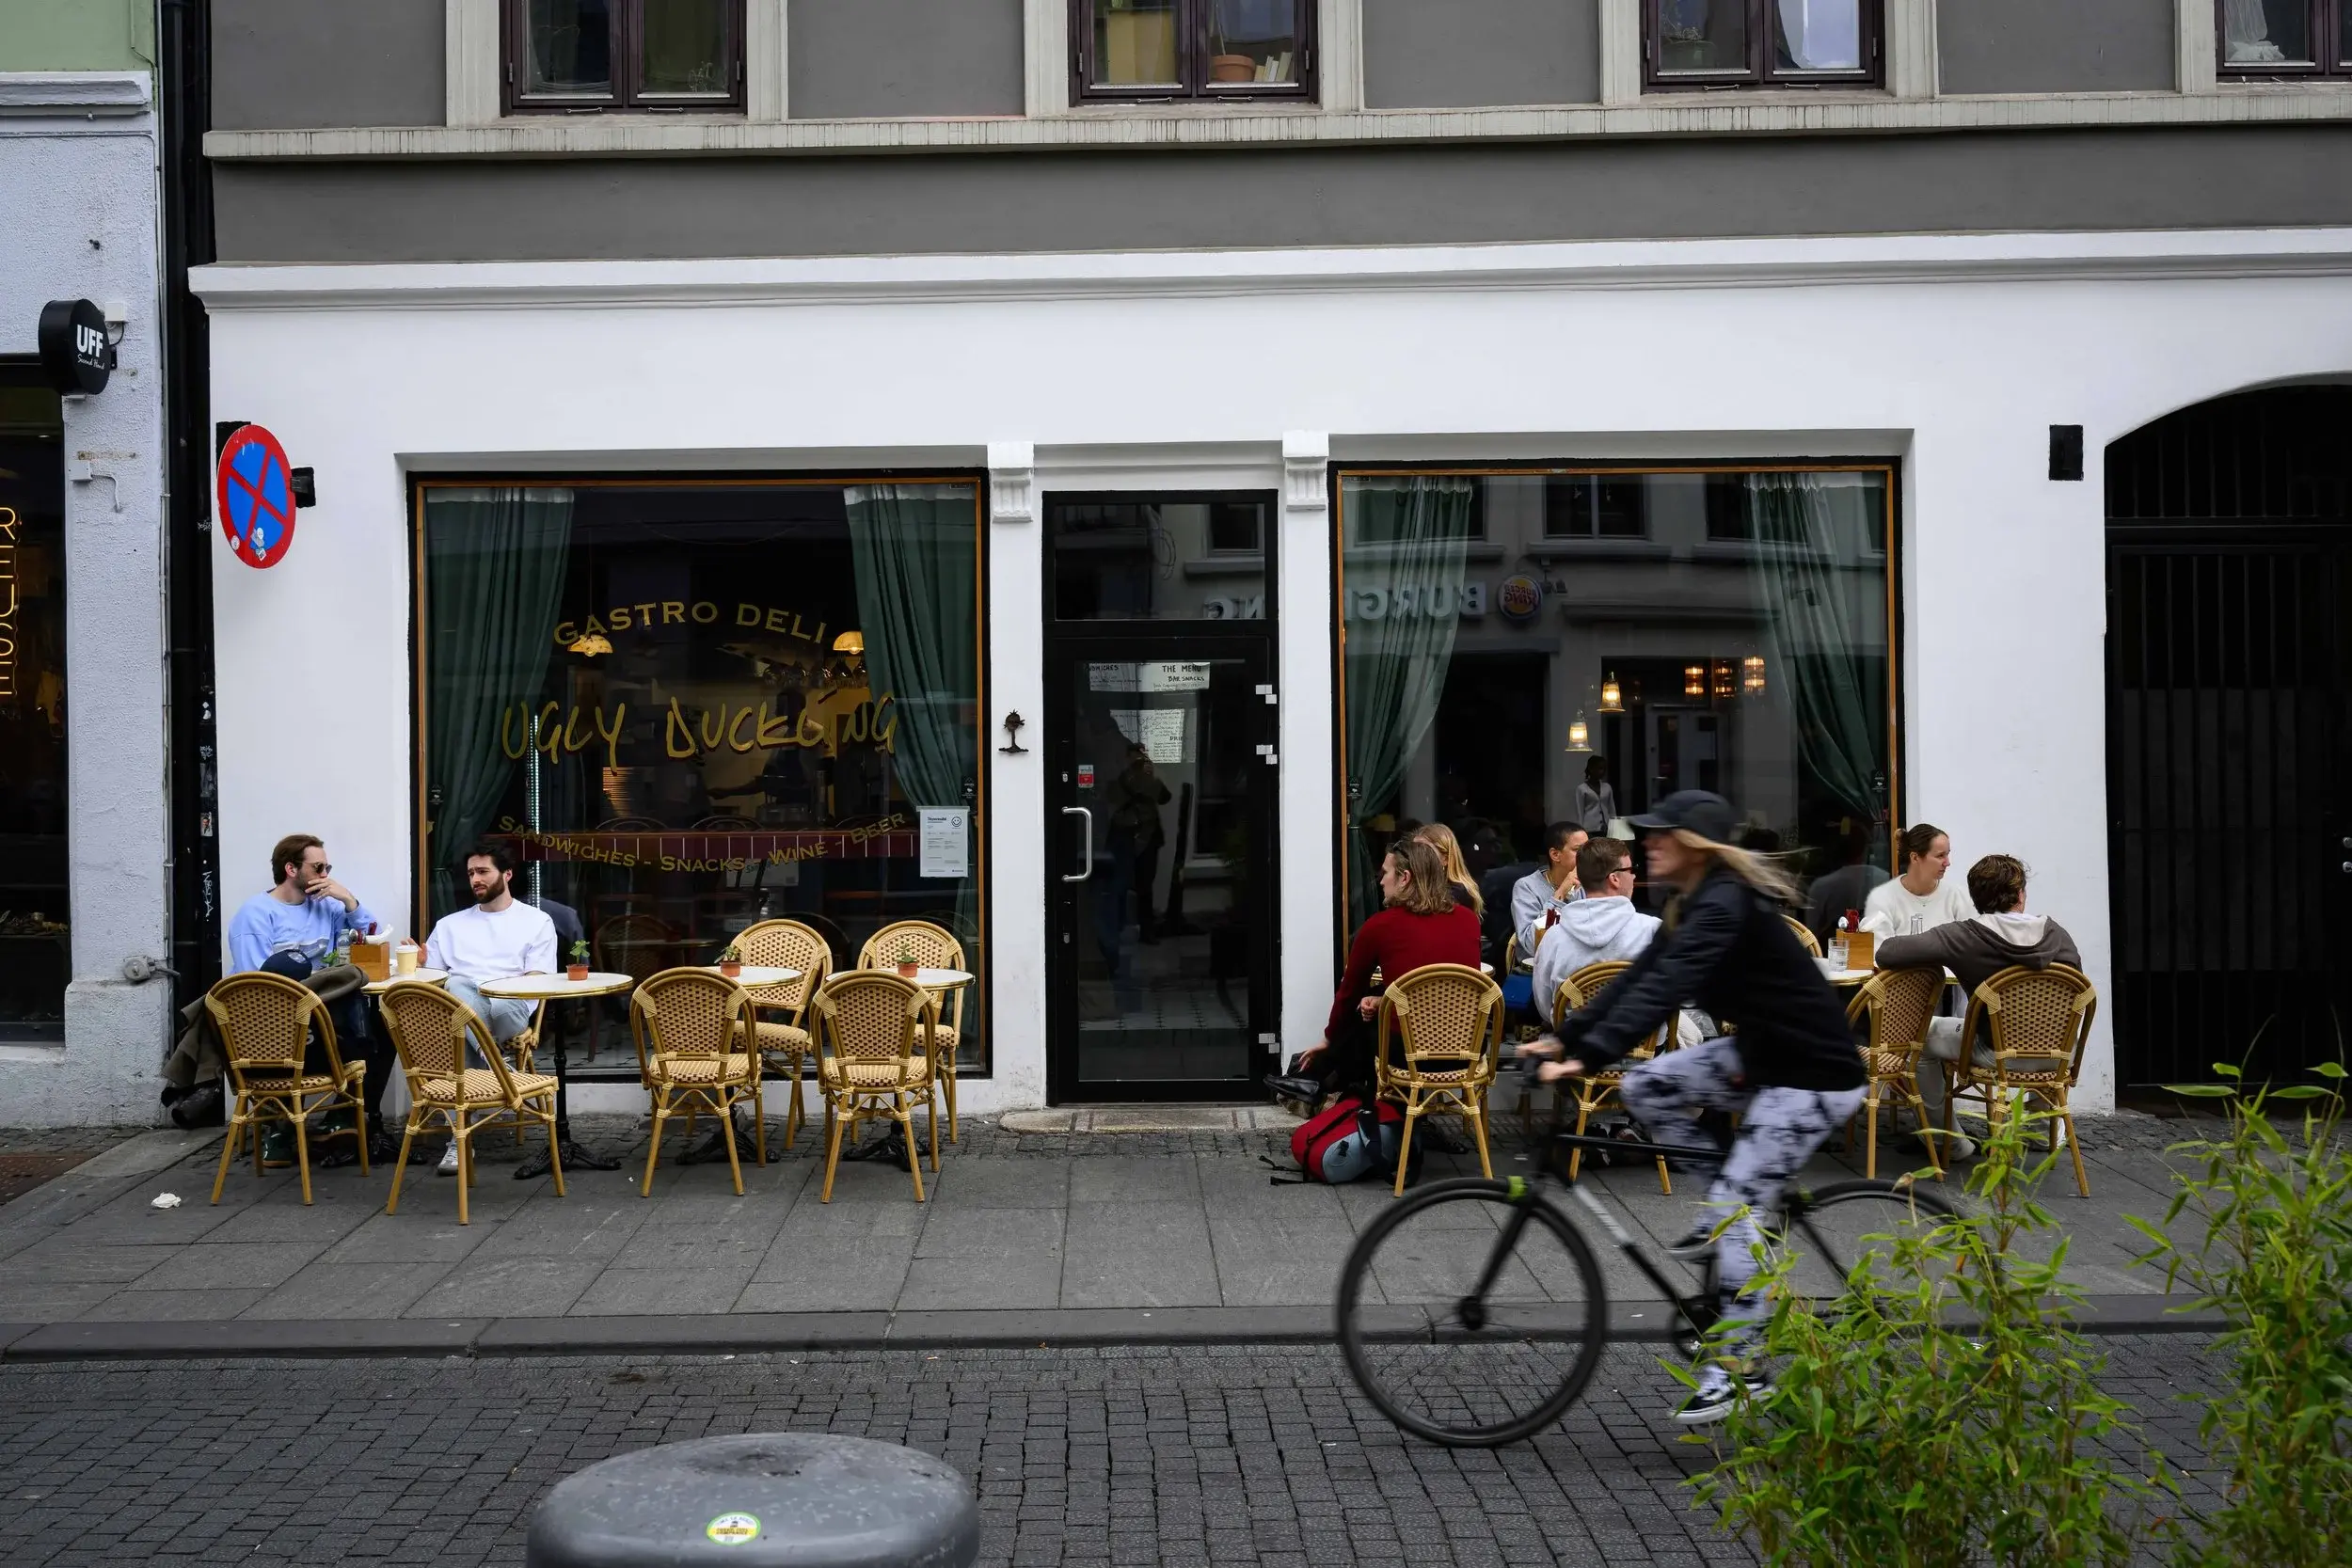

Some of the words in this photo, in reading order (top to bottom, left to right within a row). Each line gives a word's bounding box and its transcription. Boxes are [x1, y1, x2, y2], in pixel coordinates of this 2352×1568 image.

[76, 324, 103, 357] UFF
[553, 601, 718, 645] GASTRO
[736, 603, 826, 643] DELI
[1181, 664, 1201, 673] MENU
[502, 701, 626, 776] UGLY
[666, 689, 898, 759] DUCKLING
[499, 816, 637, 867] SANDWICHES
[660, 855, 746, 872] SNACKS
[768, 841, 829, 866] WINE
[850, 813, 906, 845] BEER
